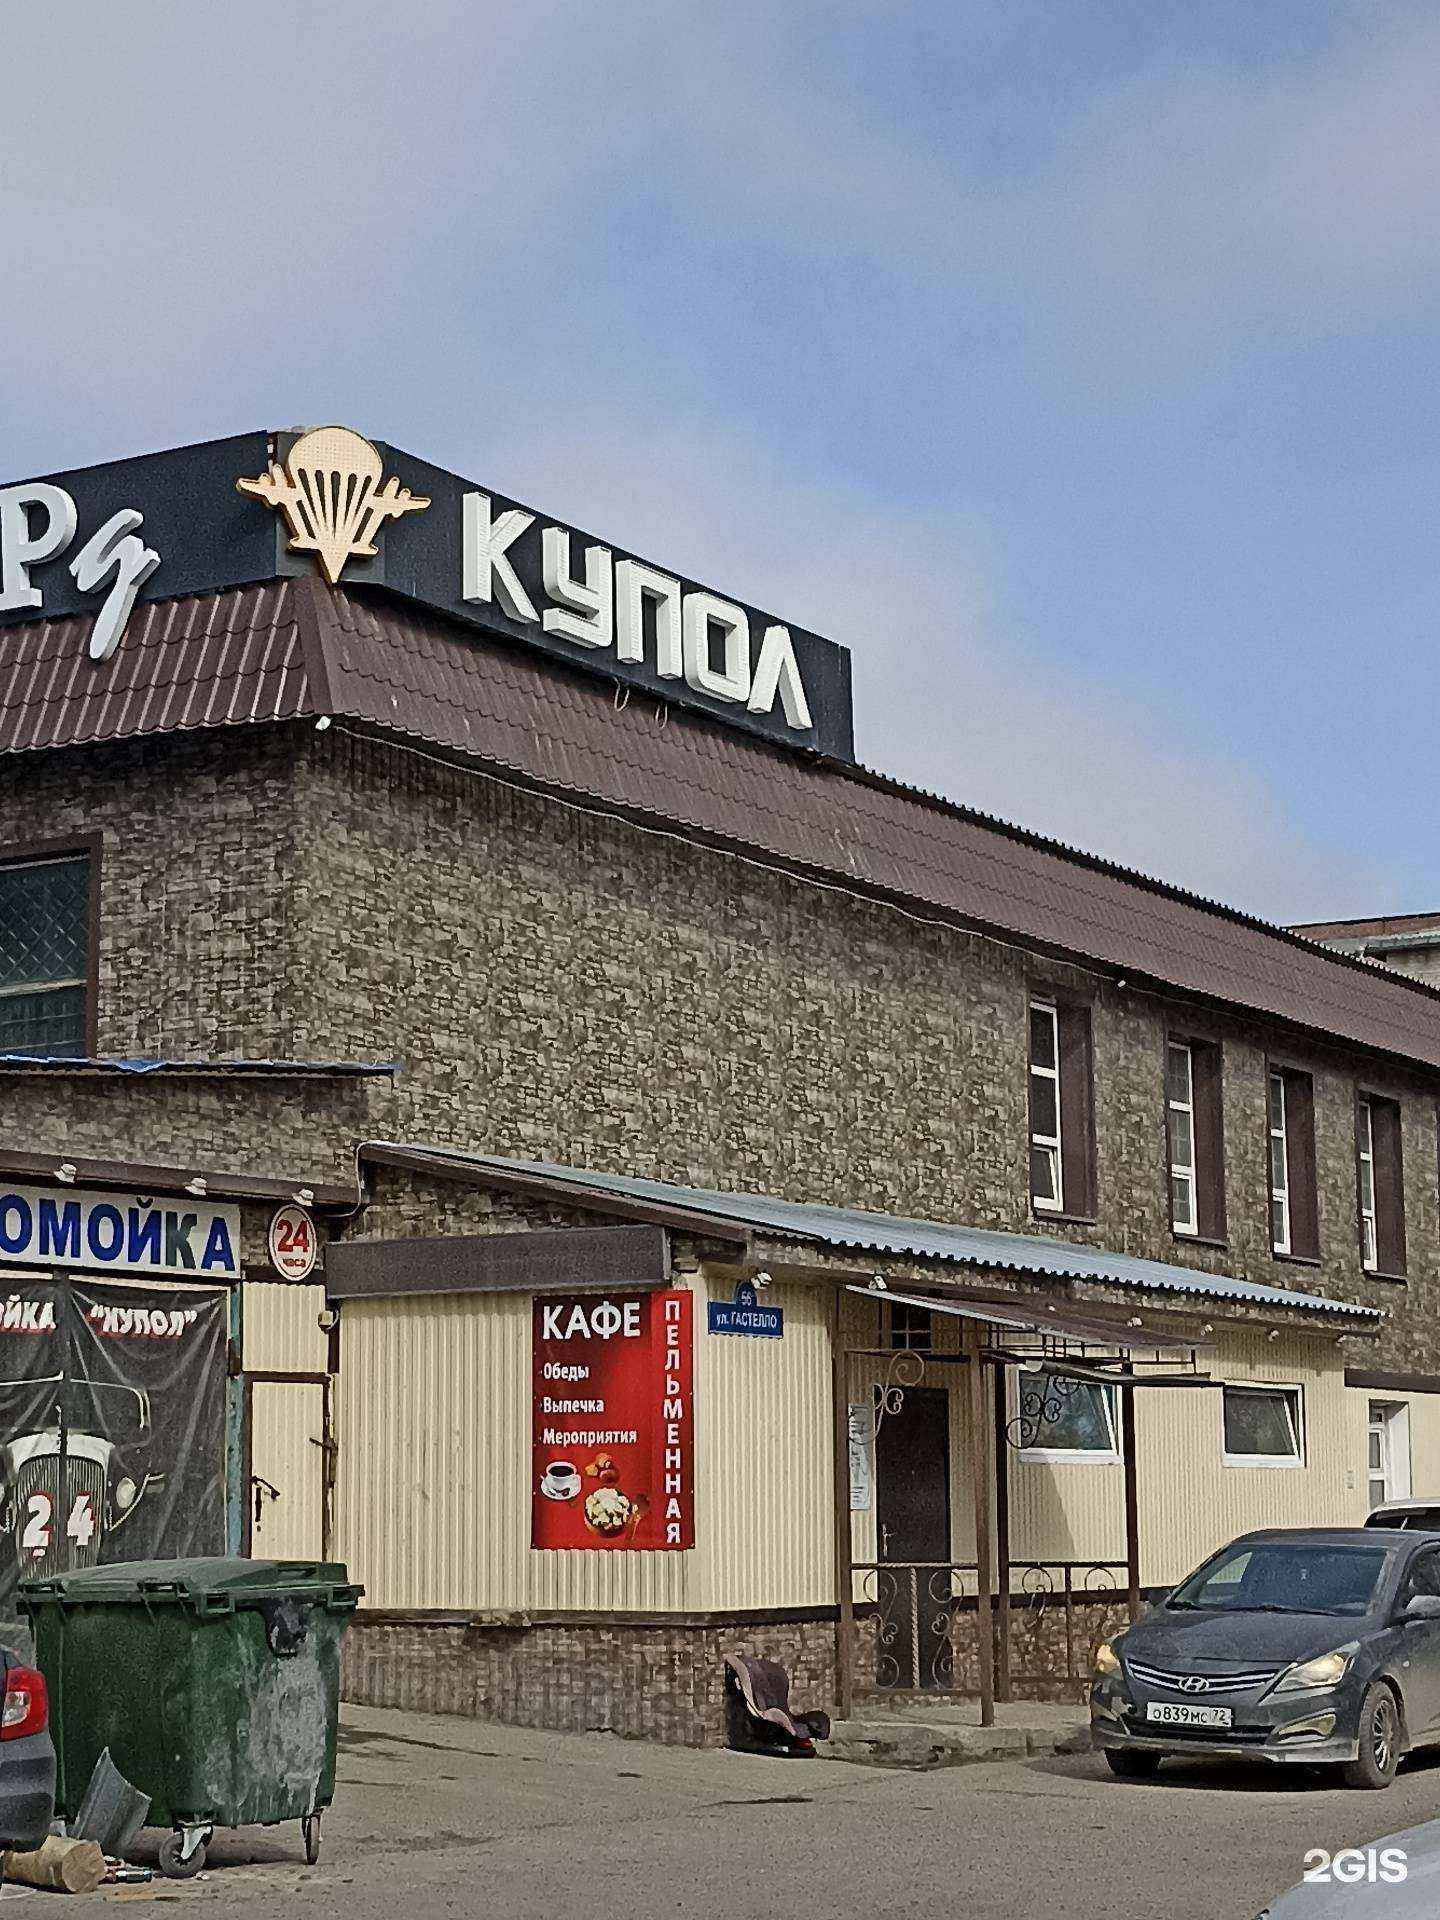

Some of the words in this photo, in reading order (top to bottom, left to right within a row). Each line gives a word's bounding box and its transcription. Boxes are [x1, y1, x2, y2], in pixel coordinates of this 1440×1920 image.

[463, 492, 813, 729] КУПОЛ
[277, 1219, 310, 1252] 24
[0, 1294, 57, 1330] ЙКА
[542, 1301, 641, 1340] КАФЕ
[716, 1312, 729, 1328] ул.
[731, 1311, 778, 1329] ГАСТЕЛЛО
[543, 1362, 590, 1381] Обеды
[543, 1396, 604, 1413] Выпечка
[542, 1428, 637, 1447] Мероприятия
[663, 1300, 683, 1544] ПЕЛЬМЕННАЯ
